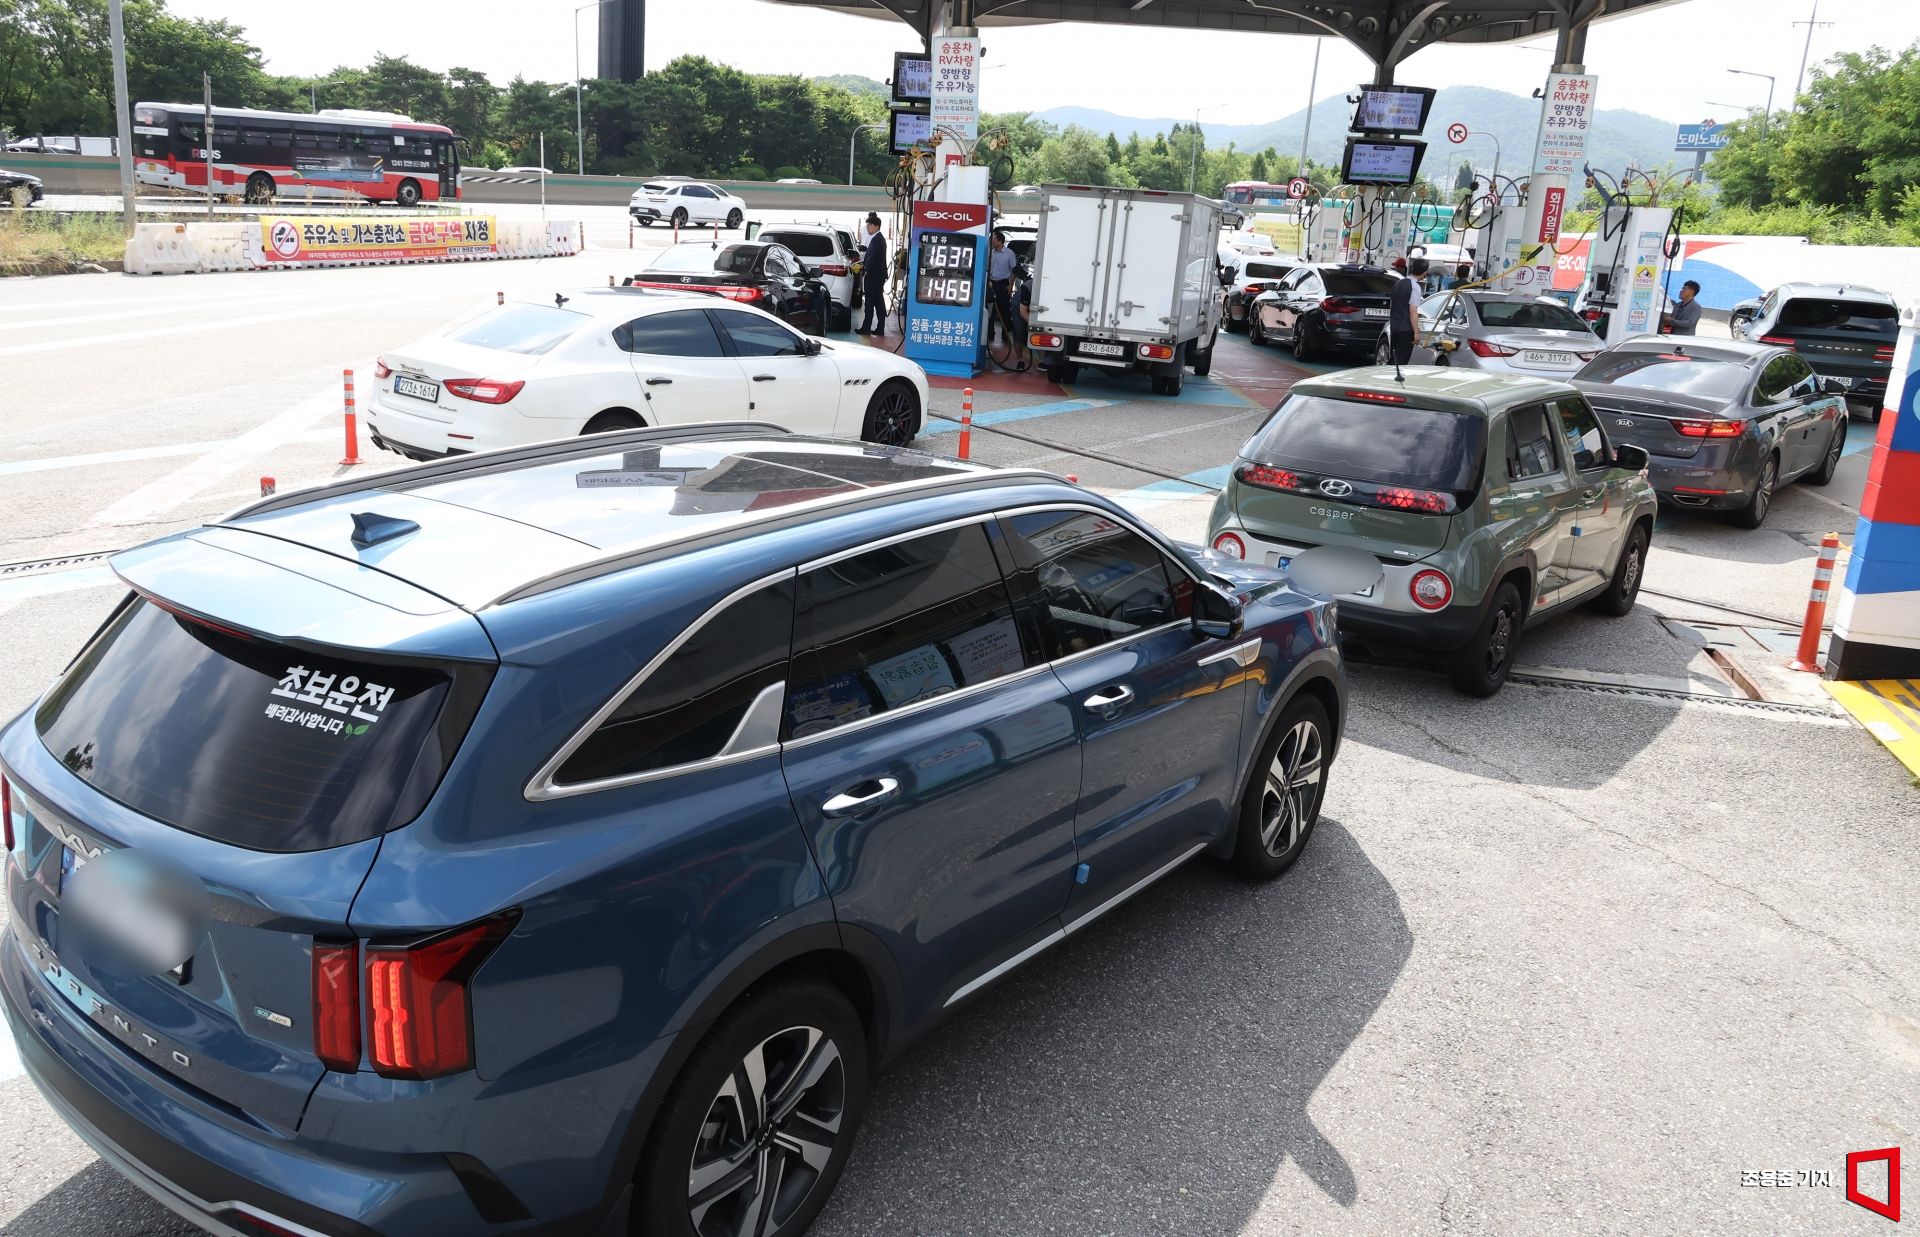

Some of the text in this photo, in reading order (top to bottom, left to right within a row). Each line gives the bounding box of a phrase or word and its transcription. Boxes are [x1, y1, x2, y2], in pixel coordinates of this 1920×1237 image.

[941, 42, 973, 54] 승용차
[939, 55, 975, 67] RV차량
[940, 68, 972, 80] 양방향
[935, 81, 976, 93] 주유가능
[1557, 79, 1589, 91] 승용차
[1553, 91, 1590, 104] RV차량
[1554, 104, 1585, 117] 양방향
[1546, 117, 1588, 130] 주유가능
[192, 148, 222, 160] RBS
[303, 220, 489, 245] 주유소 및 가스충전소 금연구역 지정
[922, 235, 947, 244] 휘발유
[929, 245, 974, 269] 1637
[927, 278, 971, 301] 1469
[911, 318, 974, 336] 정품·정량·정가
[910, 332, 973, 347] 서울 만남의광장 주유소
[1100, 345, 1120, 354] 6482
[1547, 353, 1569, 363] 3174
[418, 384, 436, 399] 1614
[270, 665, 396, 723] 초보운전
[264, 703, 344, 735] 배려감사합니다
